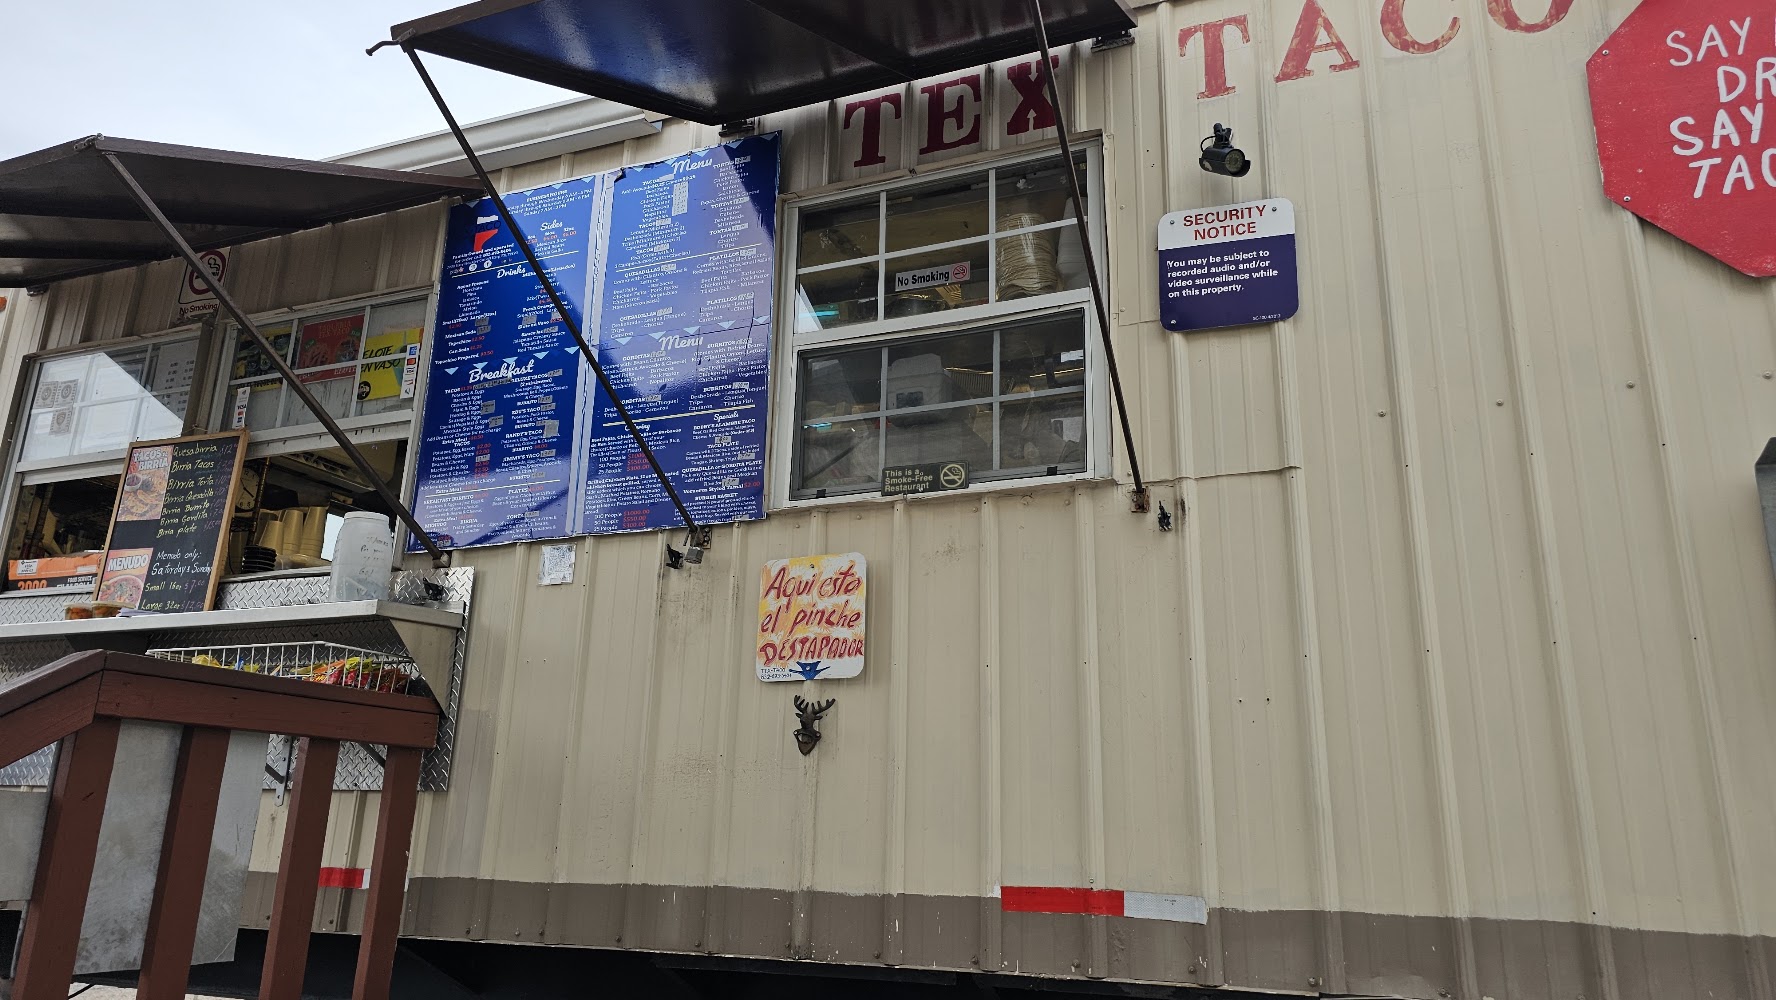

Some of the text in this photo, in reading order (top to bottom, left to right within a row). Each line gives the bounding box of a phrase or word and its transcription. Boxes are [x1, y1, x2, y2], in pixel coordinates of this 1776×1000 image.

[1666, 16, 1751, 67] SAY
[842, 54, 1060, 168] TEX
[1669, 102, 1763, 156] SAY
[671, 157, 713, 175] Menu
[1183, 204, 1267, 227] SECURITY
[540, 219, 563, 232] Sides
[1194, 221, 1257, 241] NOTICE
[1167, 249, 1270, 268] You may be subject to
[496, 265, 527, 278] Drinks
[1167, 259, 1271, 278] recorded audio and/or
[897, 270, 950, 287] No Smoking
[1167, 268, 1279, 288] video surveillance while
[1182, 287, 1200, 297] this
[1202, 283, 1245, 295] property.
[180, 302, 219, 315] No Smoking
[659, 334, 704, 351] Menu
[362, 344, 394, 360] ELOTE
[468, 359, 535, 383] Breakfast
[714, 412, 739, 422] Specials
[133, 449, 162, 462] TACOS
[173, 442, 218, 457] Quesabirria
[138, 457, 168, 471] BIRRIA
[170, 460, 192, 473] Birria
[193, 459, 215, 470] Tacos
[885, 470, 903, 478] This
[905, 468, 912, 476] is
[885, 474, 933, 485] Smoke-Free
[167, 478, 195, 490] Birria
[197, 474, 214, 486] Torta
[884, 482, 930, 493] Restaurant
[163, 492, 185, 505] Birria
[160, 517, 179, 526] Birria
[181, 508, 208, 526] Gordita
[162, 506, 181, 516] Birria
[176, 522, 198, 539] plate
[107, 553, 149, 572] MENUDO
[156, 548, 181, 561] Menudo
[151, 561, 186, 577] Saturday
[191, 561, 213, 576] Sunday
[145, 581, 166, 592] Small
[763, 564, 862, 614] Aqui esta
[141, 599, 163, 611] Large
[760, 599, 861, 637] el pinche
[760, 635, 864, 666] DESTAPADOR
